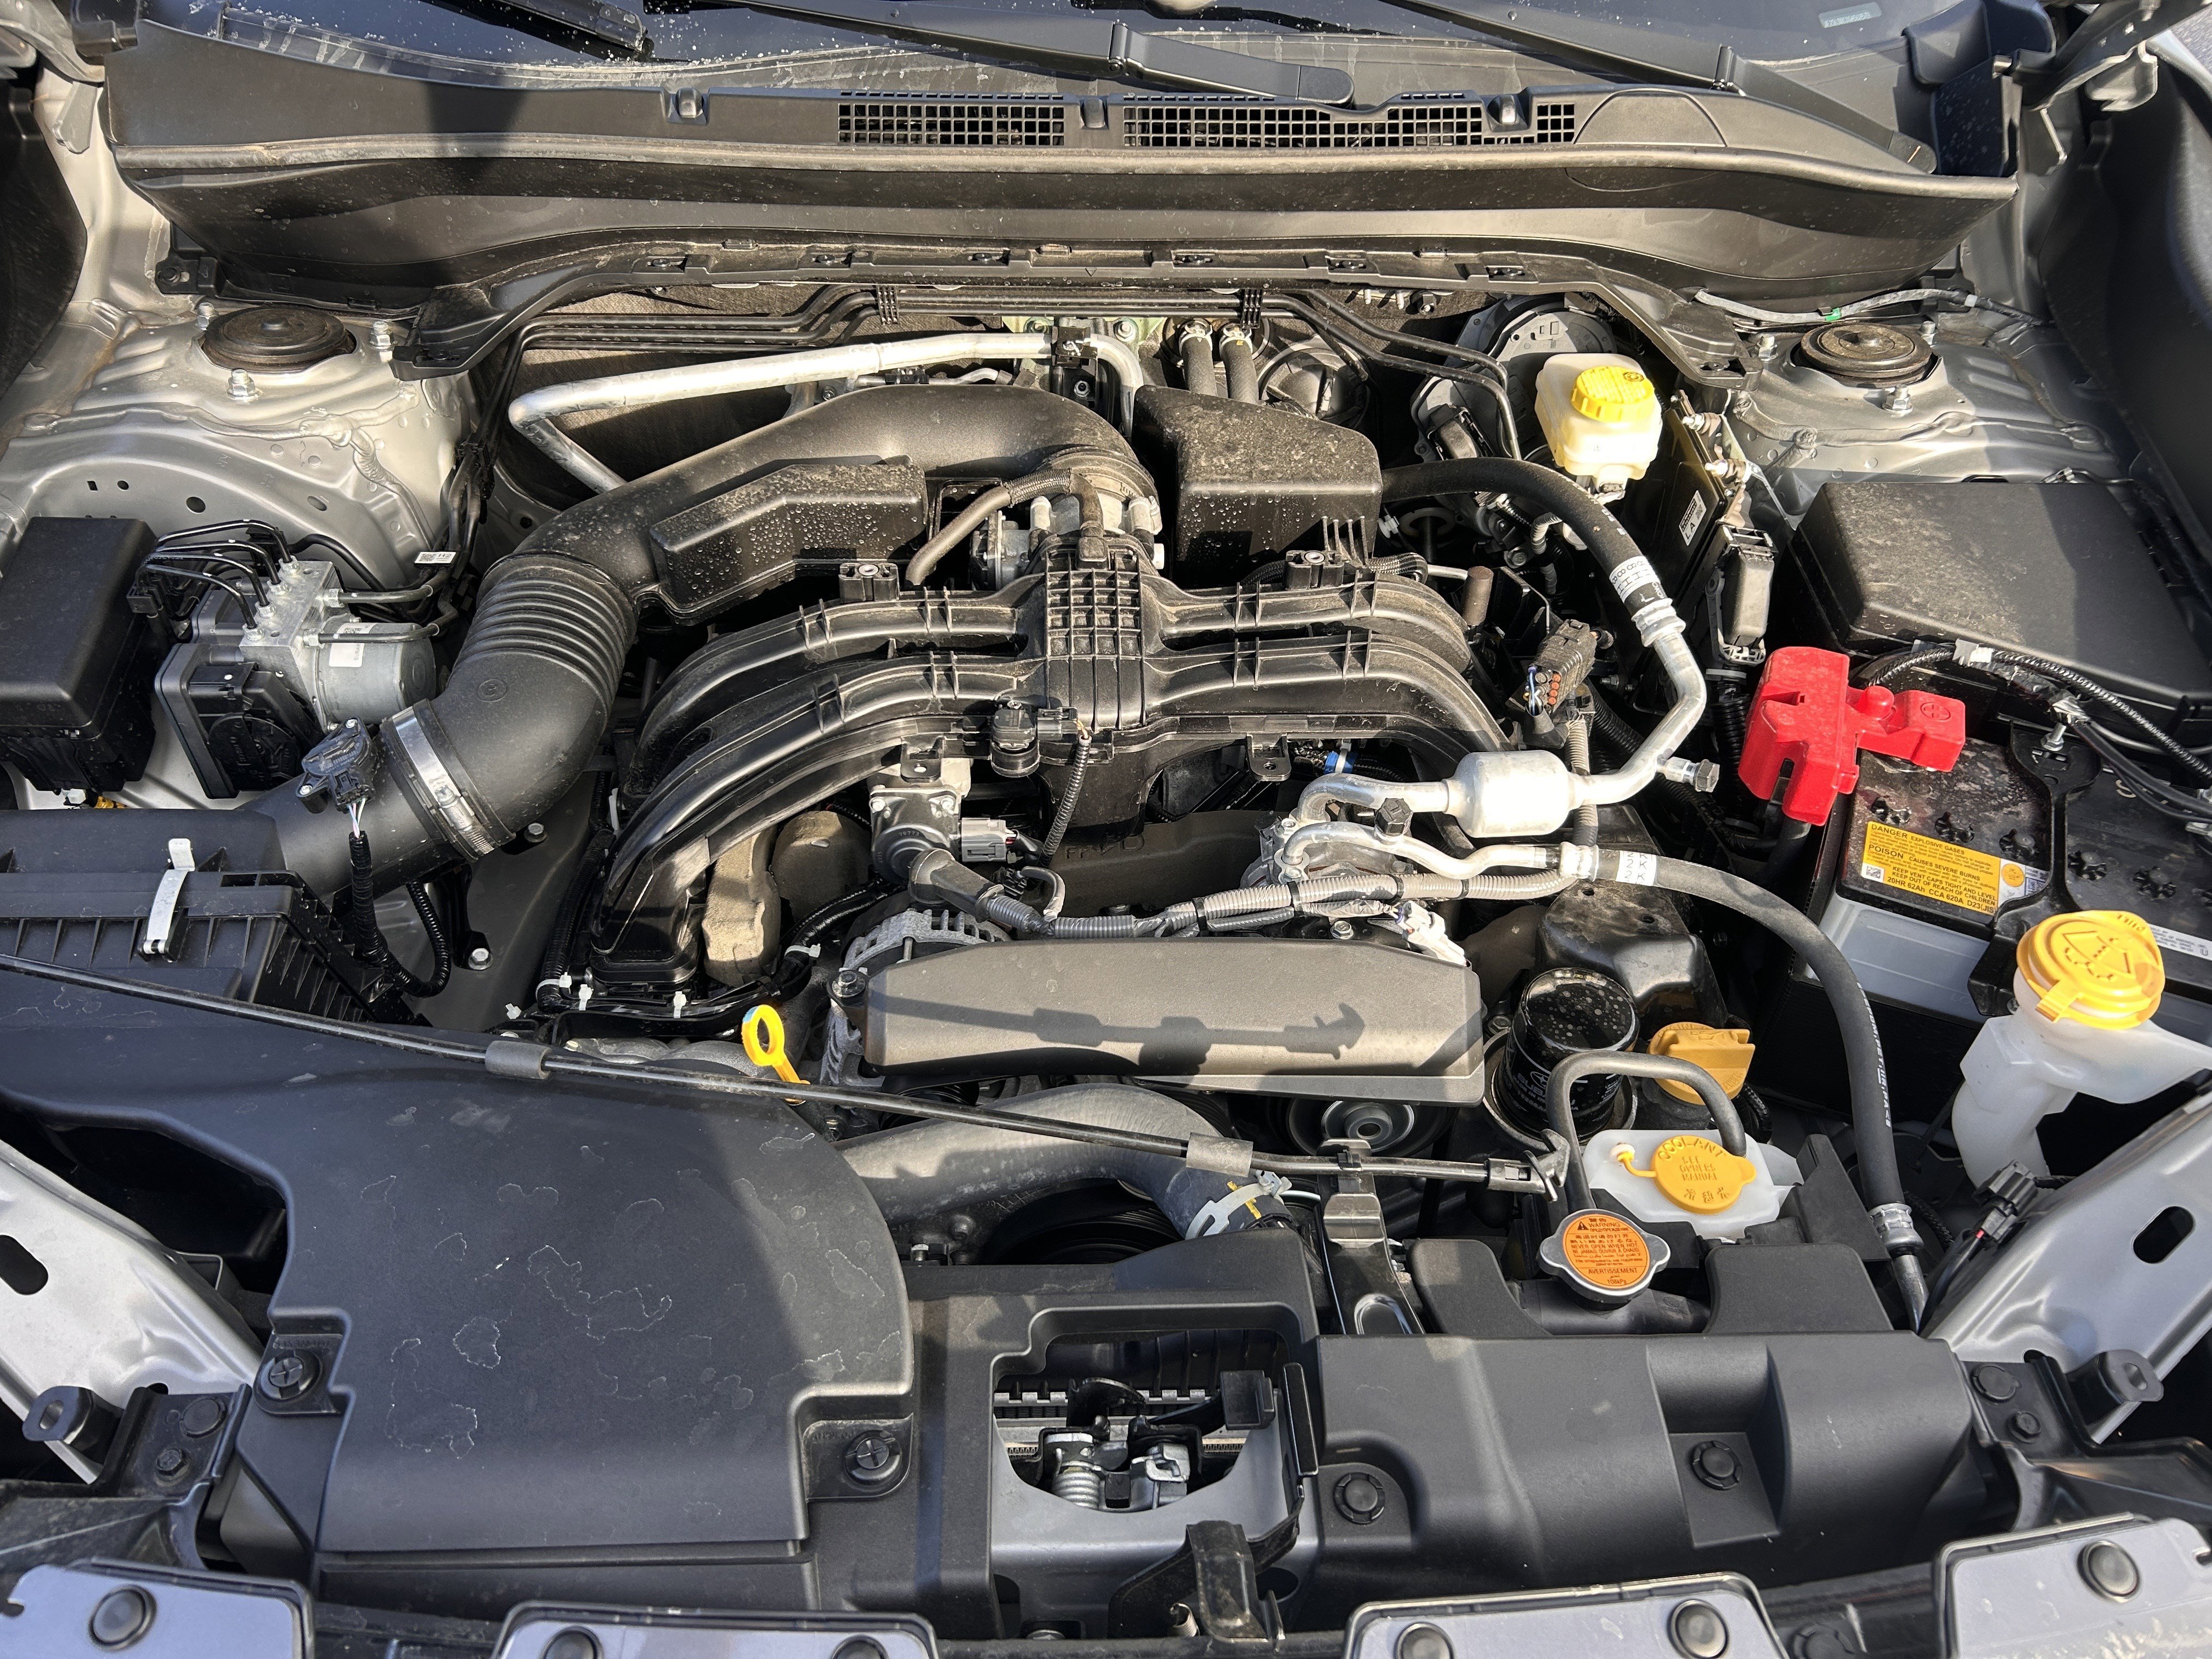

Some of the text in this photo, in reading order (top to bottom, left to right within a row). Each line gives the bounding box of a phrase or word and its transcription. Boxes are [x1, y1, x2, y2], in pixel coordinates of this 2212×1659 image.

[1872, 824, 1965, 855] DANGER EXPLOSIVE GASES
[1869, 844, 1980, 881] POISON CAUSES SEVERE BURNS
[1887, 876, 1906, 887] 20HR
[1908, 883, 1925, 893] 62Ah
[1928, 889, 1945, 899] CCA
[1946, 894, 1963, 904] 620A
[1927, 876, 1943, 884] CAPS
[1945, 881, 1962, 890] TIGHT
[1977, 890, 1997, 901] LEVEL
[1933, 883, 1954, 893] REACH
[1965, 893, 1996, 905] CHILDREN
[1658, 1137, 1724, 1160] COOLANT
[1681, 1172, 1717, 1181] MANUAL
